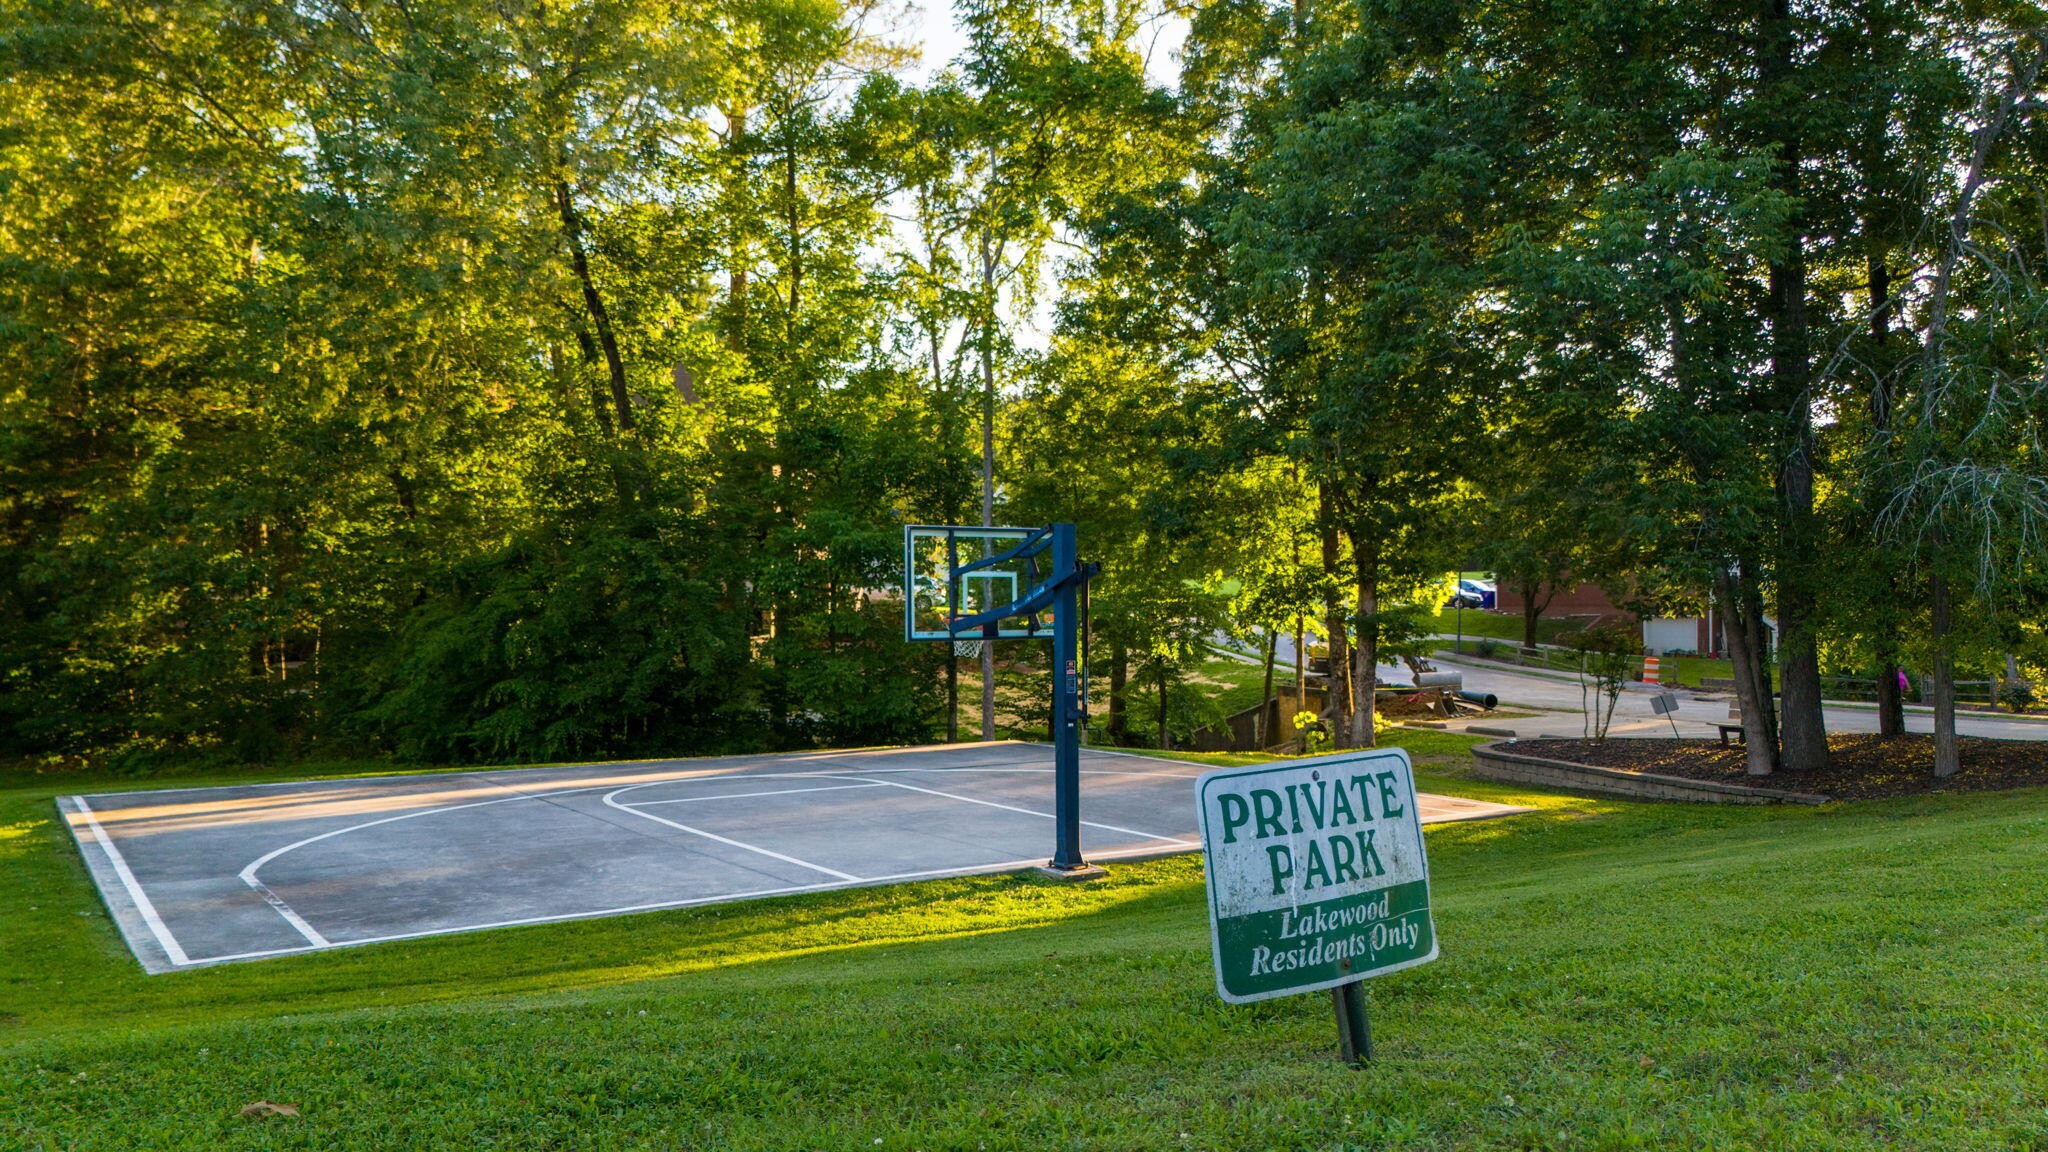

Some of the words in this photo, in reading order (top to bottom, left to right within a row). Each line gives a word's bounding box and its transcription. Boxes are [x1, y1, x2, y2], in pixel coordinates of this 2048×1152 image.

[1217, 770, 1403, 844] PRIVATE
[1266, 829, 1386, 895] PARK
[1279, 893, 1390, 940] Lakewood
[1249, 932, 1365, 976] Residents
[1371, 919, 1419, 950] Only
